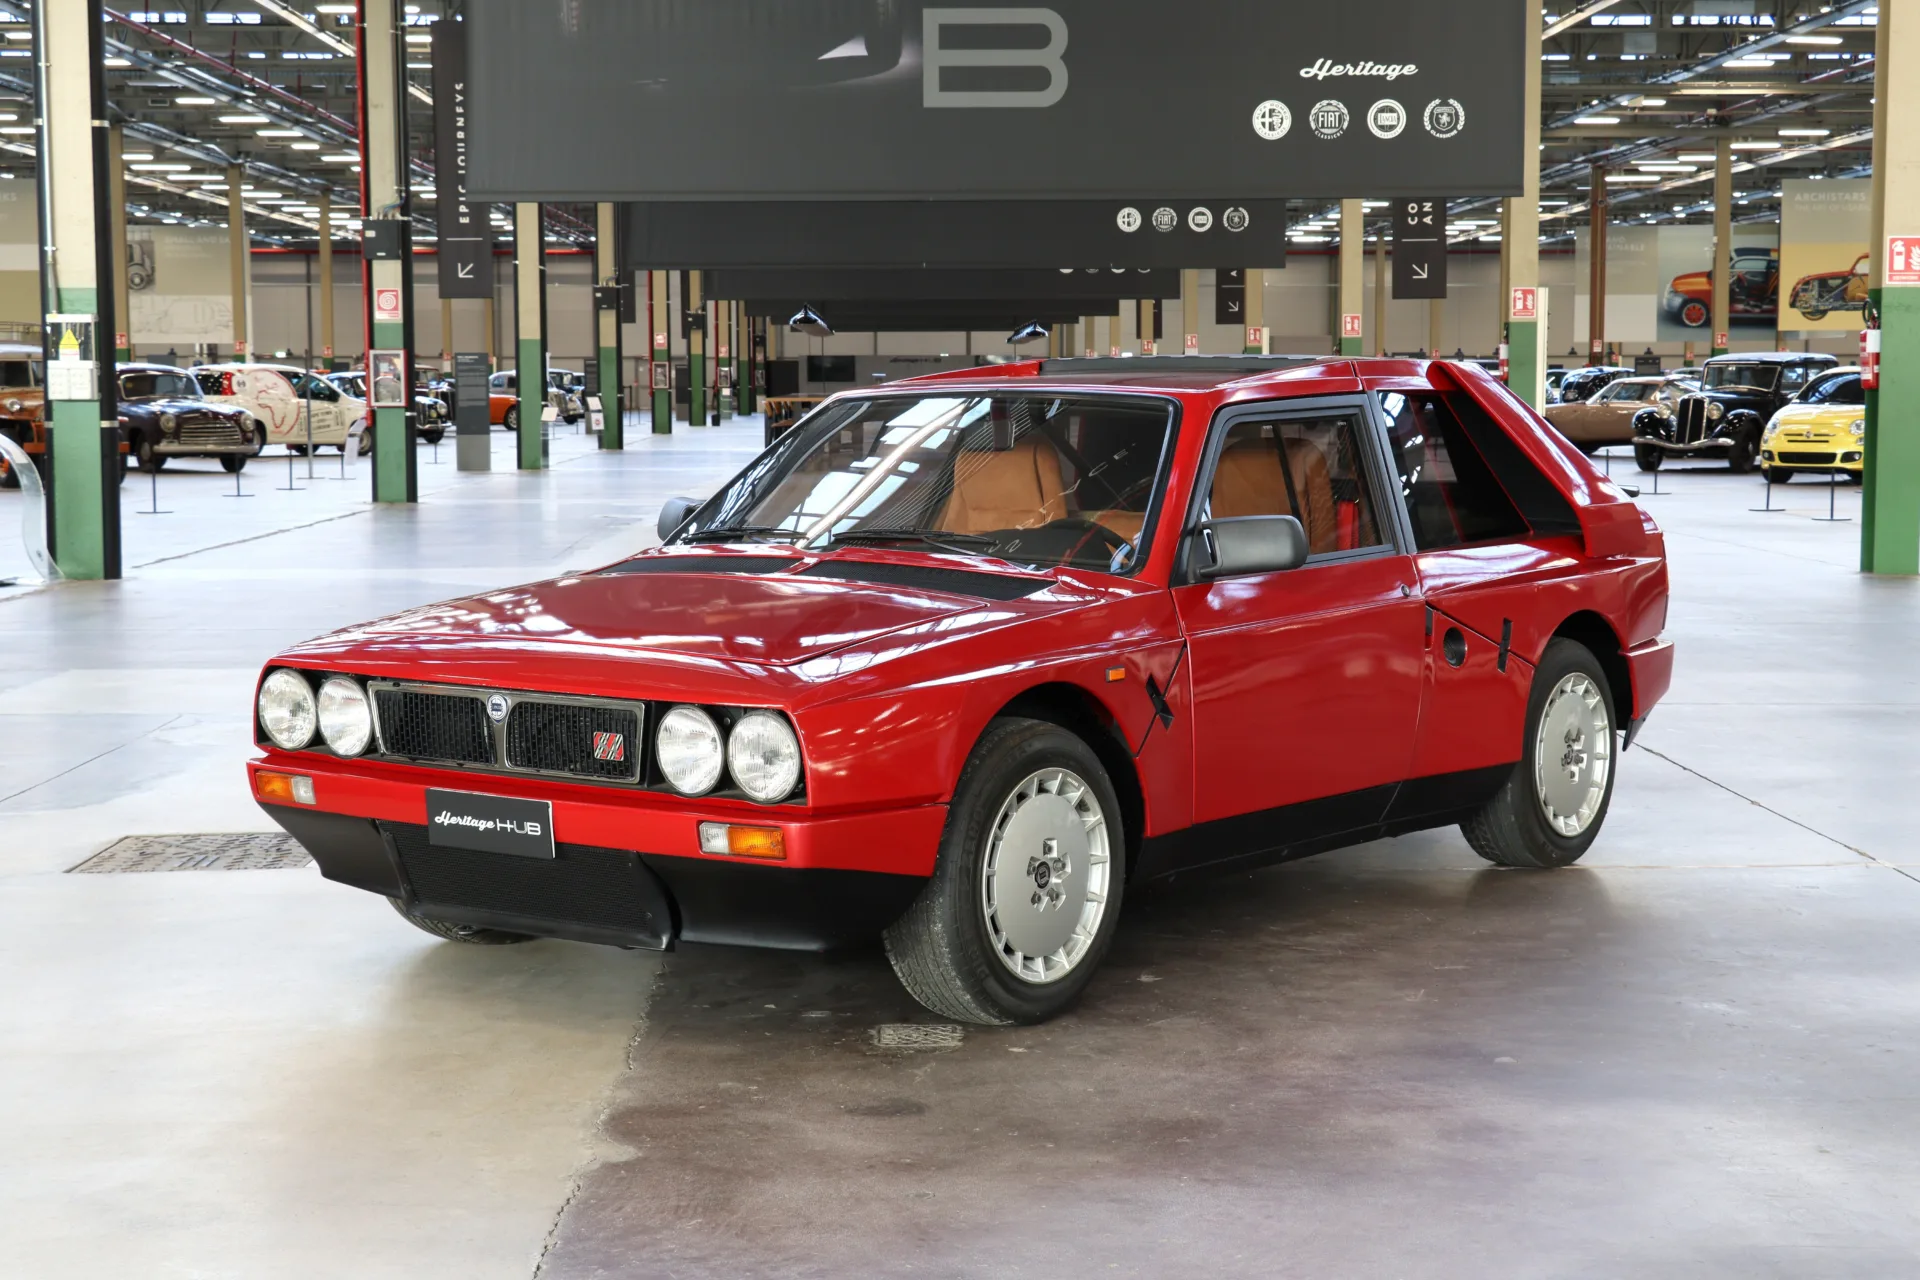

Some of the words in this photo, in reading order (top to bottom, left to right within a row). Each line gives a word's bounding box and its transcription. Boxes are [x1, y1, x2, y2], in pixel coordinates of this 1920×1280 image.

[923, 8, 1069, 107] B
[1299, 58, 1418, 80] Heritage
[1318, 112, 1340, 128] FIAT
[1794, 192, 1866, 202] ARCHISTARS
[1157, 214, 1172, 225] FIAT
[434, 810, 495, 832] Heritage
[496, 818, 542, 836] HUB
